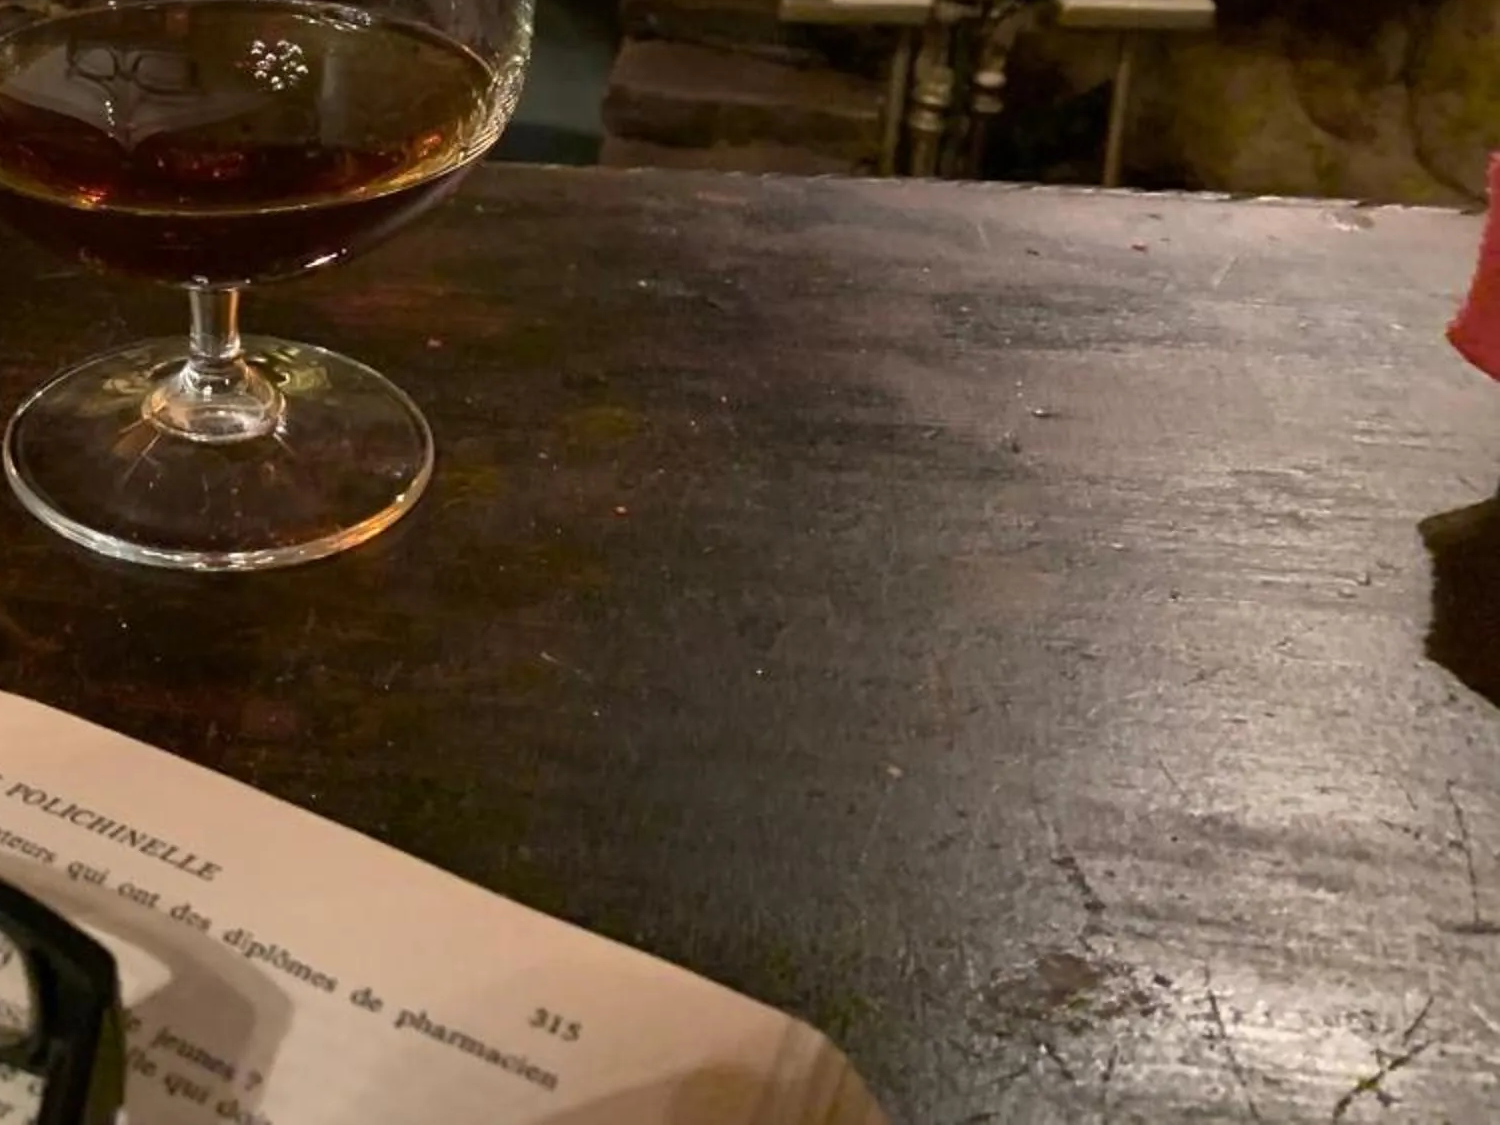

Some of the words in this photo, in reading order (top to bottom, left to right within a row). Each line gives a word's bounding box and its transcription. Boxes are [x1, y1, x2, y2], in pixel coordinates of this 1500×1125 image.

[5, 780, 224, 883] POLICHINELLE
[66, 859, 110, 888] qui
[117, 878, 163, 910] ont
[169, 903, 214, 933] des
[222, 925, 340, 994] diplômes
[349, 984, 385, 1014] de
[393, 1007, 561, 1092] pharmacien
[528, 1006, 584, 1045] 315
